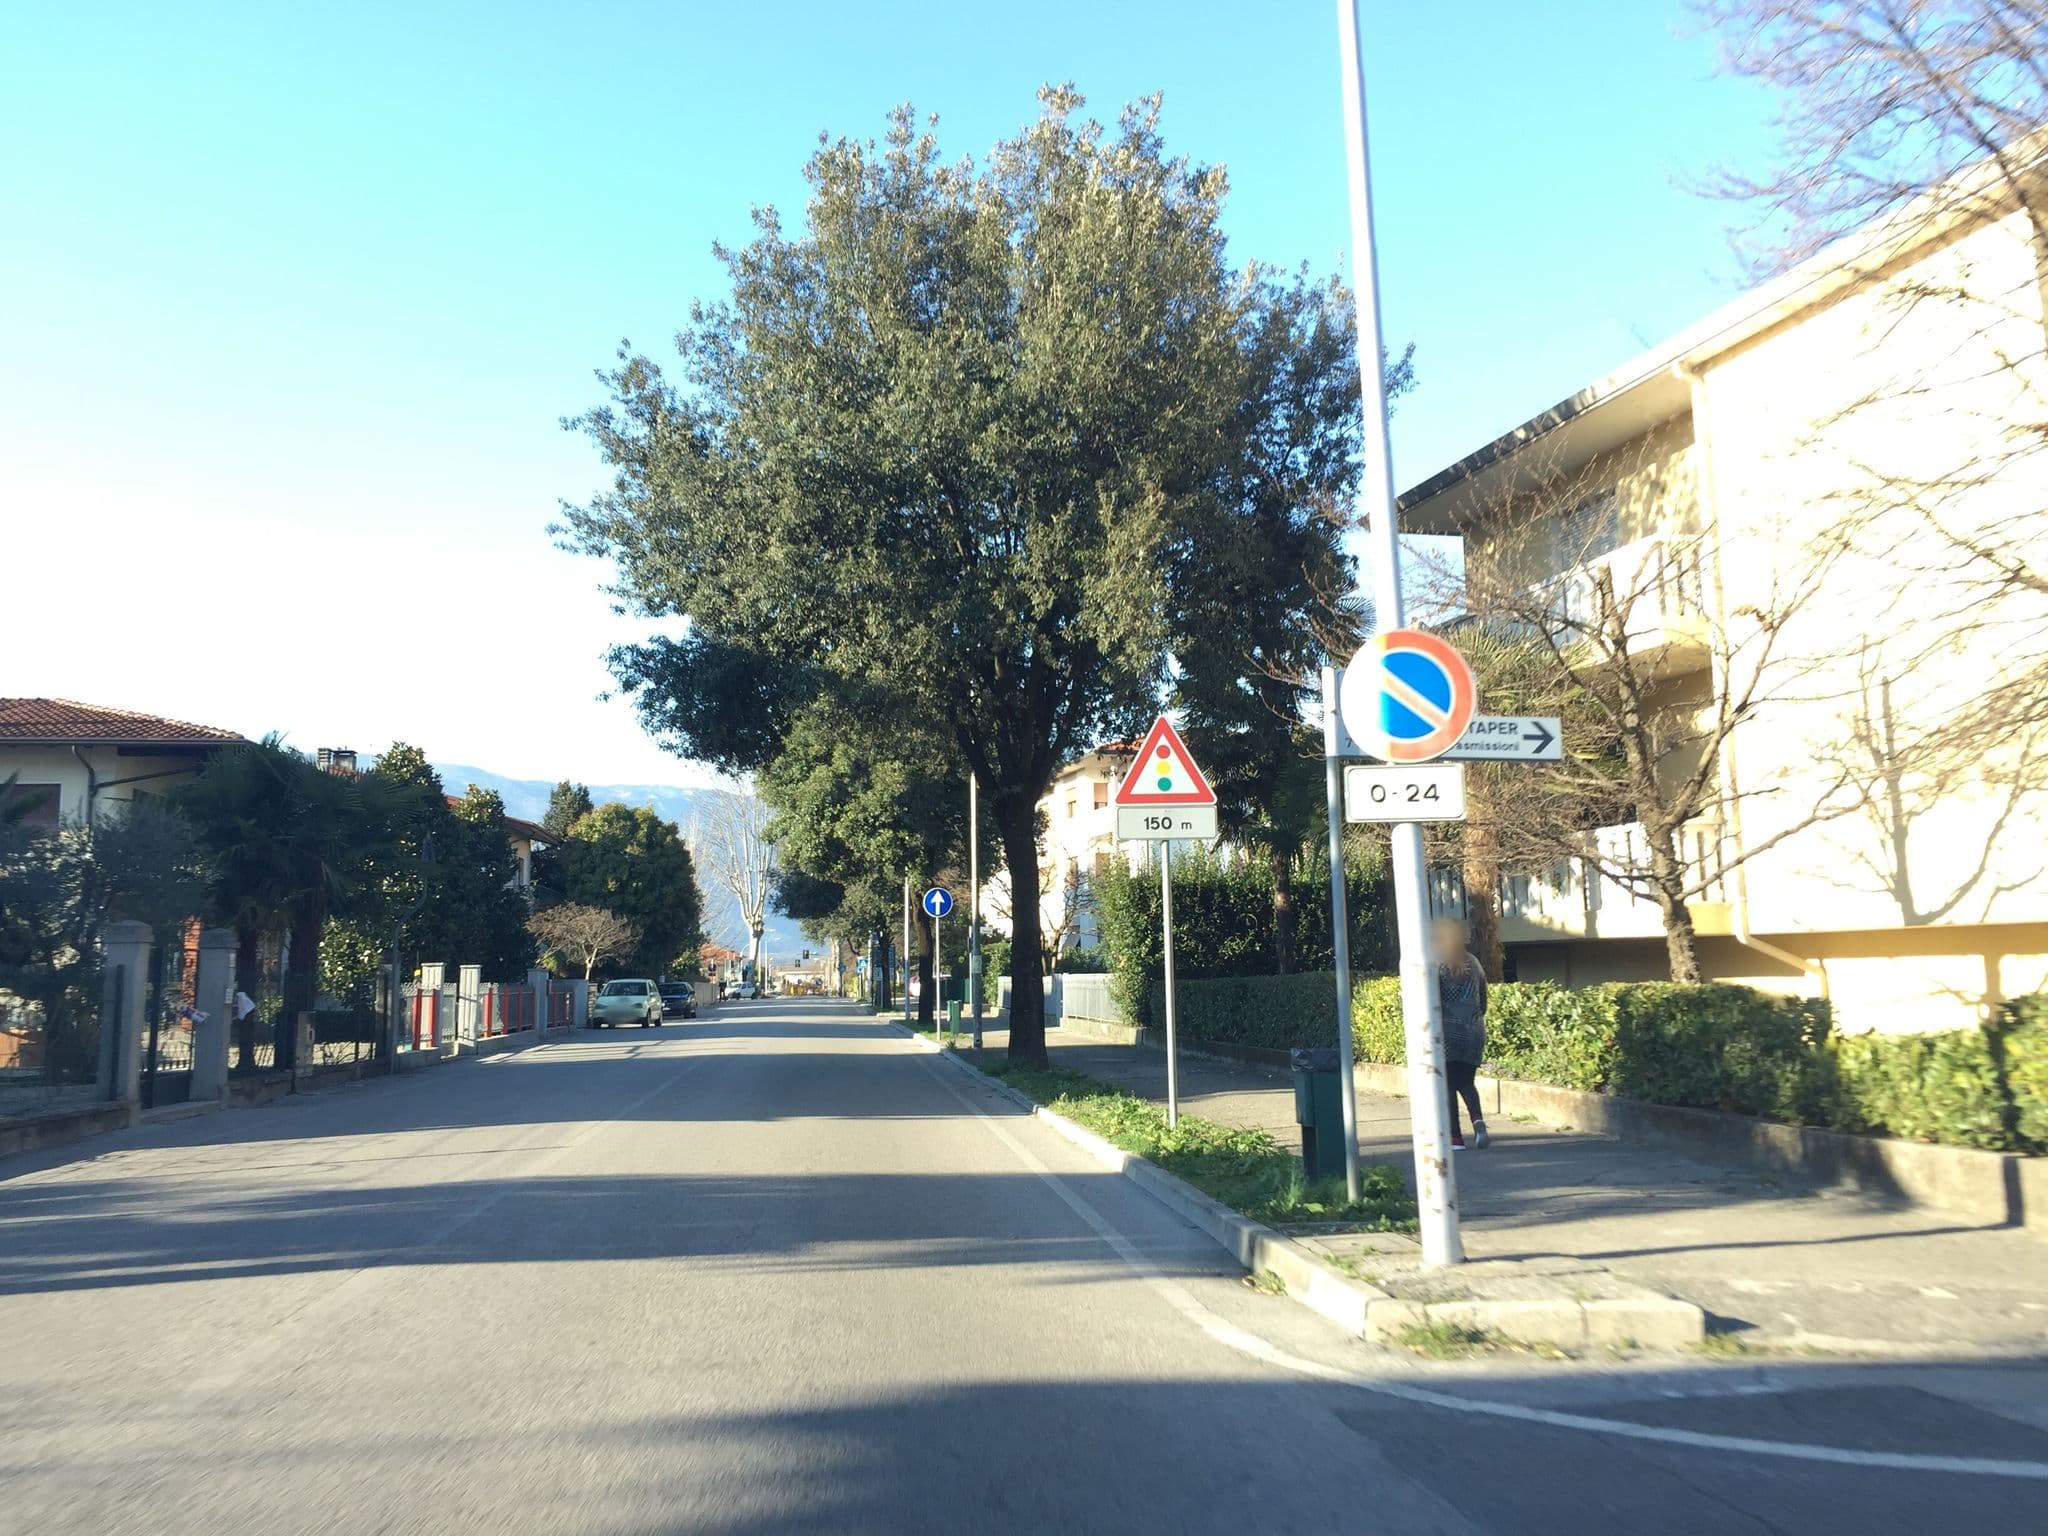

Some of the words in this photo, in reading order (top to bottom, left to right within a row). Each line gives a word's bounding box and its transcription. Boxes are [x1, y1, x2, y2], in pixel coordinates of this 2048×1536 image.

[1456, 741, 1519, 751] asmissioni
[1143, 816, 1172, 830] 150
[1181, 822, 1192, 830] m
